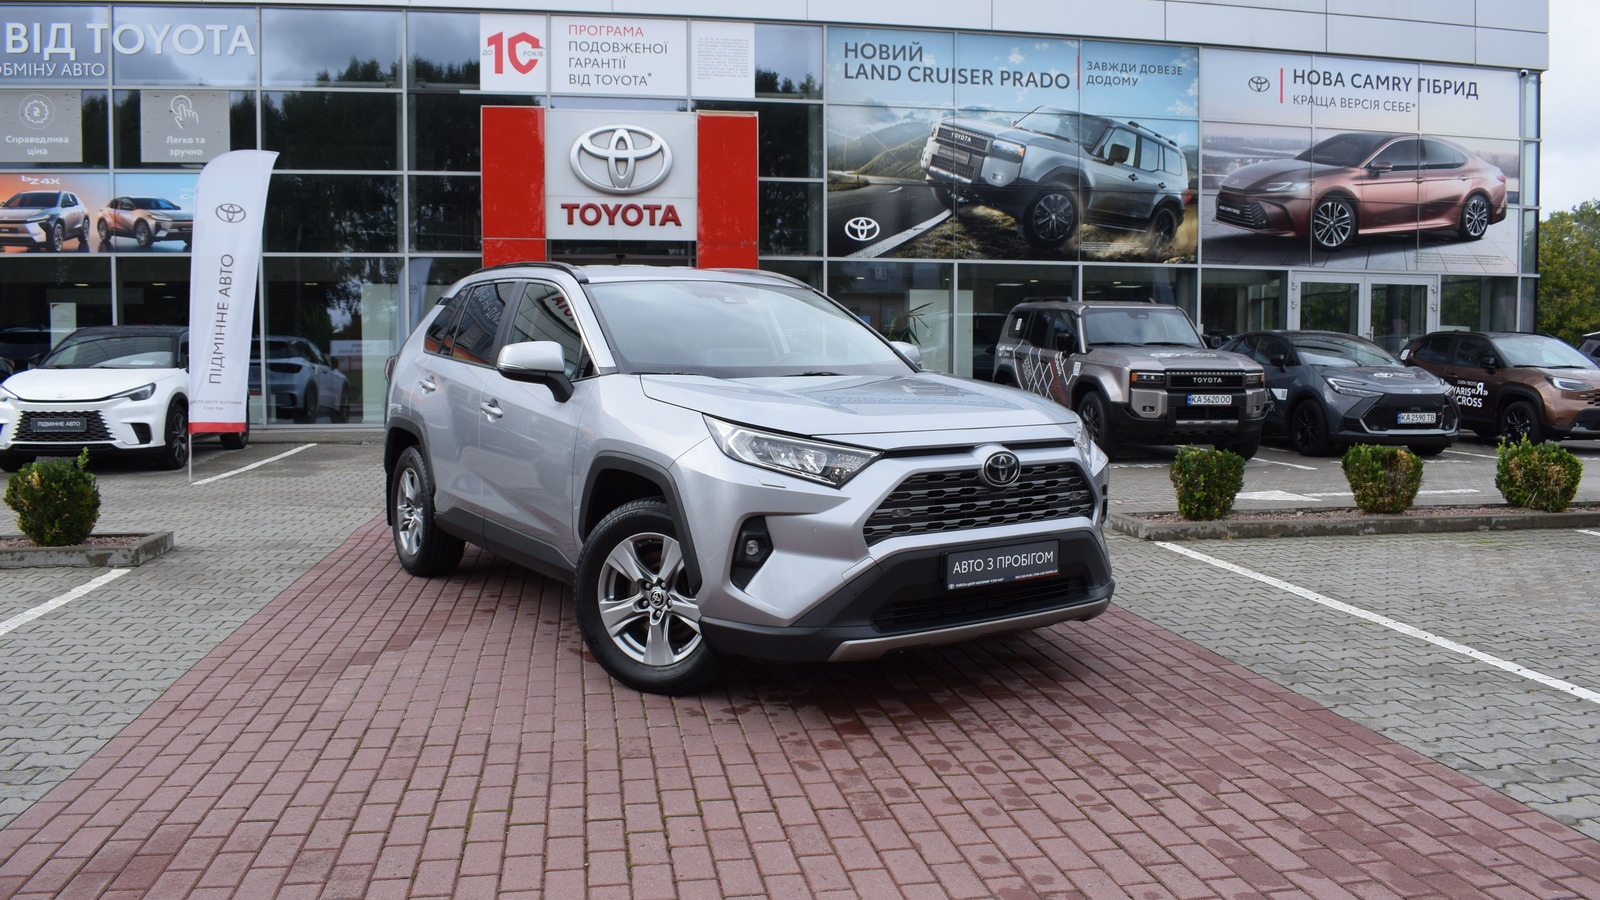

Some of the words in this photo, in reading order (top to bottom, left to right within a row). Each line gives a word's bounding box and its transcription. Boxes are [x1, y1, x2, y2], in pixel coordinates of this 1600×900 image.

[568, 24, 644, 37] ПРОГРАМА
[5, 22, 76, 61] ВІД
[86, 23, 256, 56] TOYOTA
[568, 41, 669, 55] ПОДОВЖЕНОЇ
[844, 41, 923, 62] НОВИЙ
[0, 62, 56, 77] БМІНУ
[61, 63, 106, 77] АВТО
[568, 57, 626, 70] ГАРАНТІЇ
[1086, 61, 1137, 74] ЗАВЖДИ
[1140, 64, 1184, 77] ДОВЕЗЕ
[569, 74, 591, 87] ВІД
[844, 63, 902, 81] LAND
[907, 67, 994, 87] CRUISER
[1000, 70, 1071, 90] PRADO
[1086, 75, 1139, 87] ДОДОМУ
[1293, 69, 1346, 88] НОВА
[1351, 73, 1413, 93] CAMRY
[1418, 78, 1479, 101] ГІБРИД
[1293, 95, 1337, 109] КРАЩА
[1340, 98, 1380, 111] ВЕРСІЯ
[5, 135, 70, 146] Справедлива
[166, 136, 194, 145] Легко
[196, 137, 206, 145] та
[951, 132, 971, 142] TOYOTA
[27, 147, 48, 156] ціна
[169, 148, 203, 157] зручно
[561, 203, 682, 227] TOYOTA
[218, 254, 234, 298] АВТО
[209, 302, 230, 384] ПІДМІННЕ
[1452, 386, 1471, 396] YARIS
[1191, 395, 1202, 403] KA
[1203, 395, 1220, 403] 5620
[1456, 395, 1483, 408] CROSS
[953, 559, 984, 574] АВТО
[987, 557, 994, 570] З
[996, 551, 1054, 569] ПРОБІГОМ
